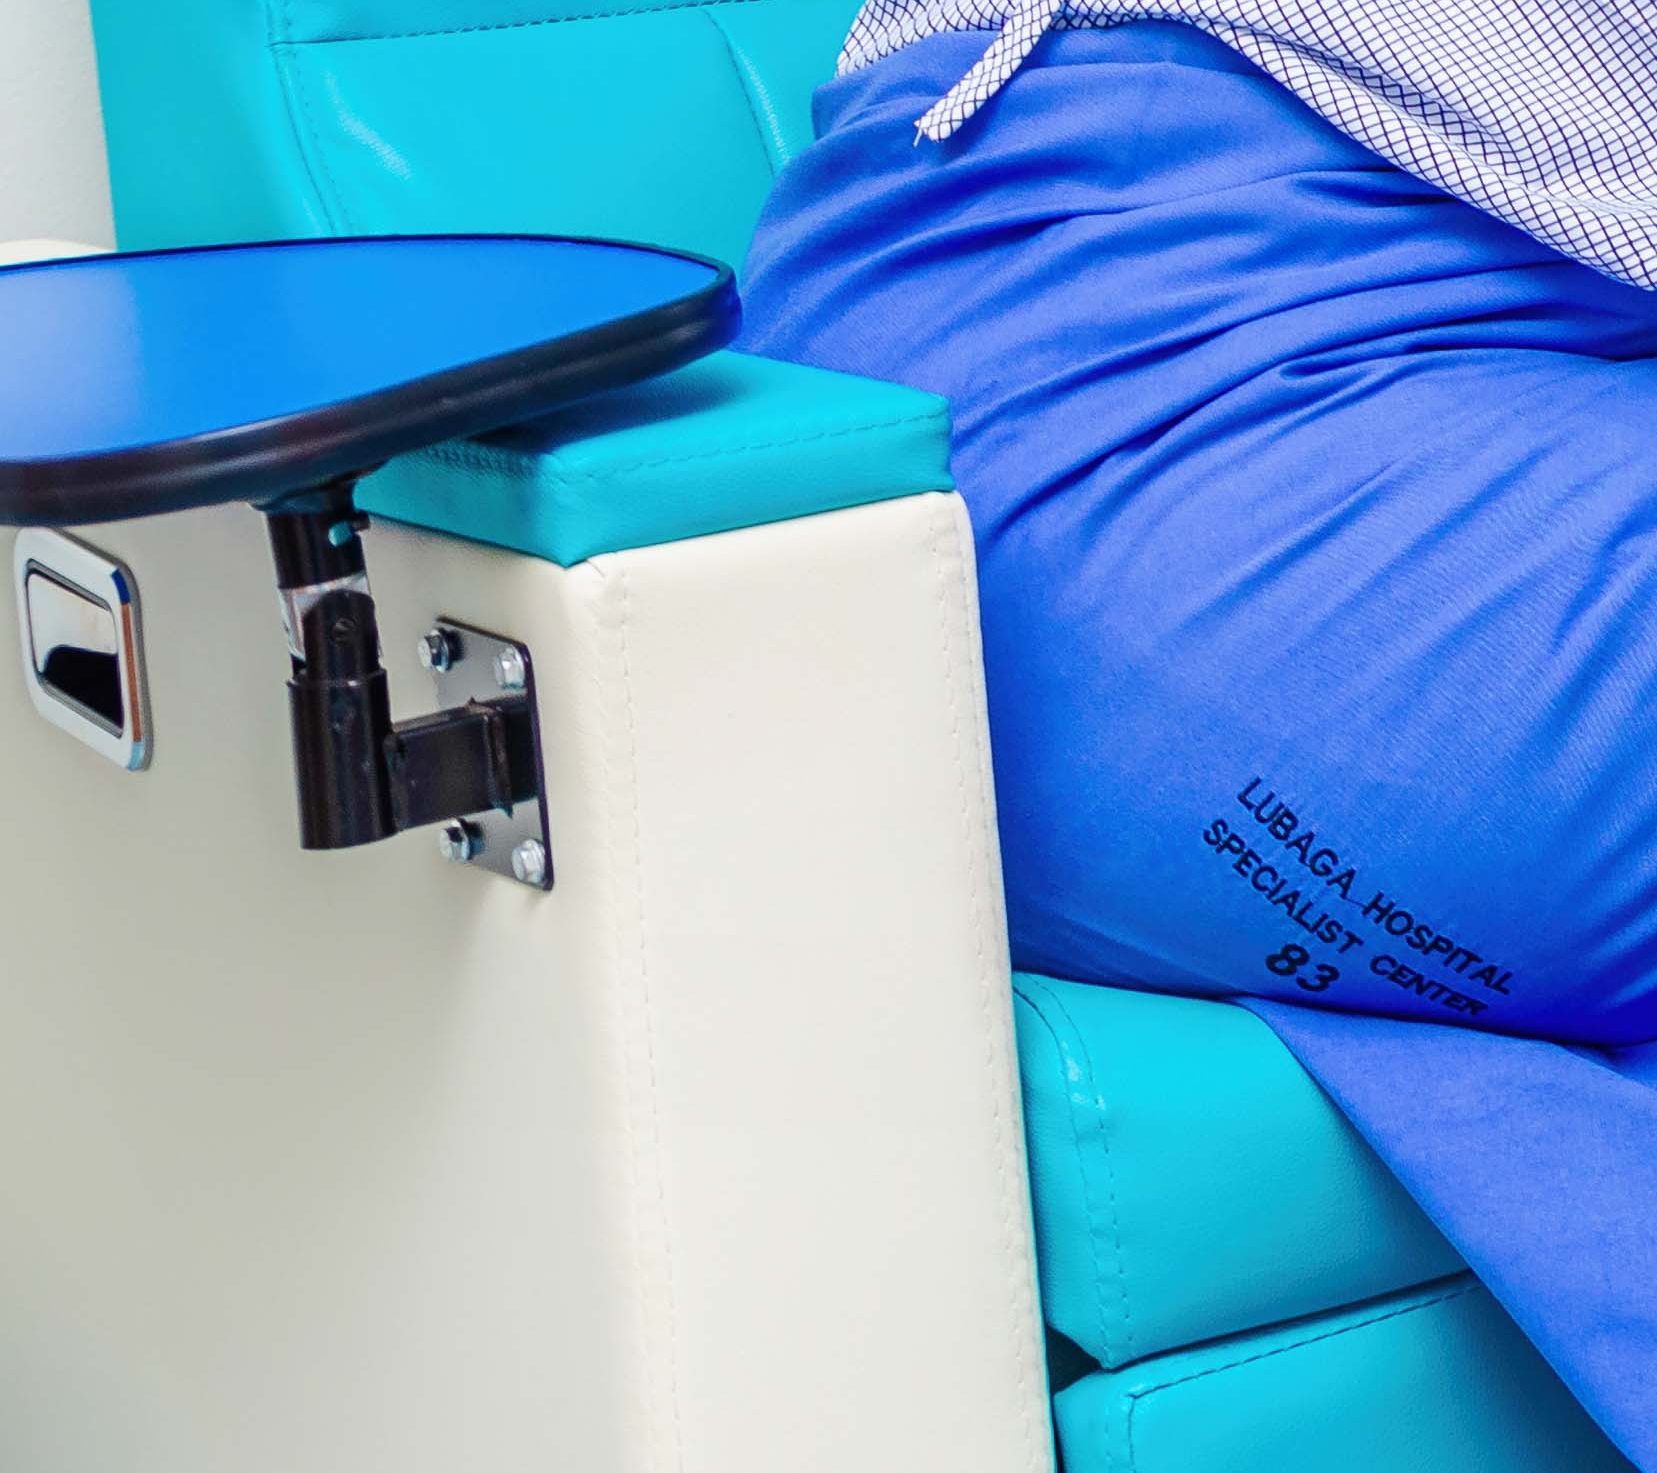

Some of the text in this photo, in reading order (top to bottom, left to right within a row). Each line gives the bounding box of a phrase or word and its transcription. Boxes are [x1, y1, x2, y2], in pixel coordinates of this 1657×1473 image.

[1202, 818, 1489, 1016] SPECIALIST CENTER
[1237, 777, 1516, 995] LUBAGA HOSPITAL
[1264, 943, 1340, 993] 83
